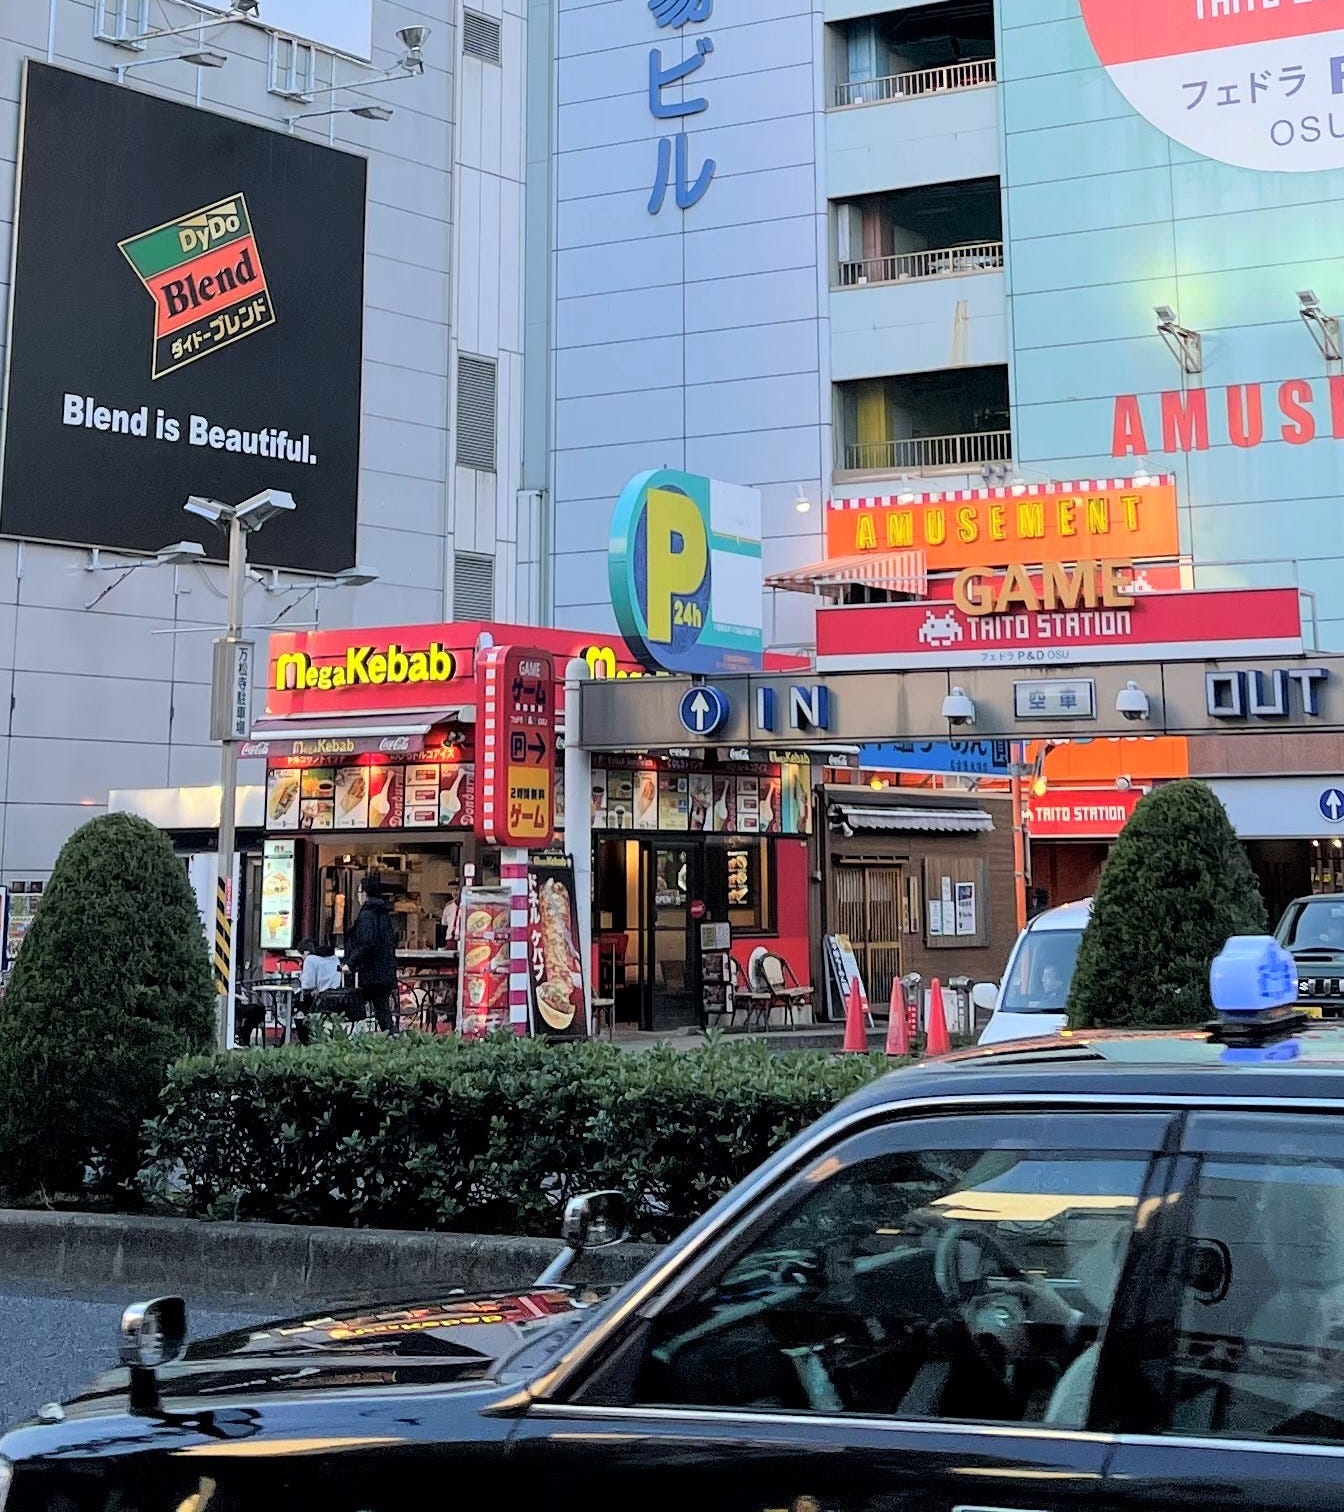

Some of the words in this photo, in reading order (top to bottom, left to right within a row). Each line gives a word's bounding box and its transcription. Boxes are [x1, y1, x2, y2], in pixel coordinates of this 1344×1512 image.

[1181, 64, 1305, 111] フェドラ
[178, 210, 241, 253] DyDo
[160, 247, 257, 319] Blend
[171, 296, 267, 361] ダイドーブレンド
[62, 392, 149, 439] Blend
[156, 408, 181, 442] is
[188, 414, 318, 465] Beautiful.
[855, 494, 1144, 552] AMUSEMENT
[647, 488, 707, 643] P
[952, 558, 1136, 617] GAME
[673, 600, 702, 628] 24h
[966, 614, 1029, 640] TAITO
[1037, 611, 1133, 638] STATION
[519, 660, 541, 677] GAME
[1017, 650, 1045, 661] P&D
[1047, 649, 1070, 660] OSU
[236, 647, 248, 735] 万松寺駐車場
[757, 685, 828, 732] IN
[1206, 668, 1328, 718] OUT
[511, 803, 545, 830] ゲーム
[1036, 807, 1070, 822] TAITO
[1074, 805, 1126, 821] STATION
